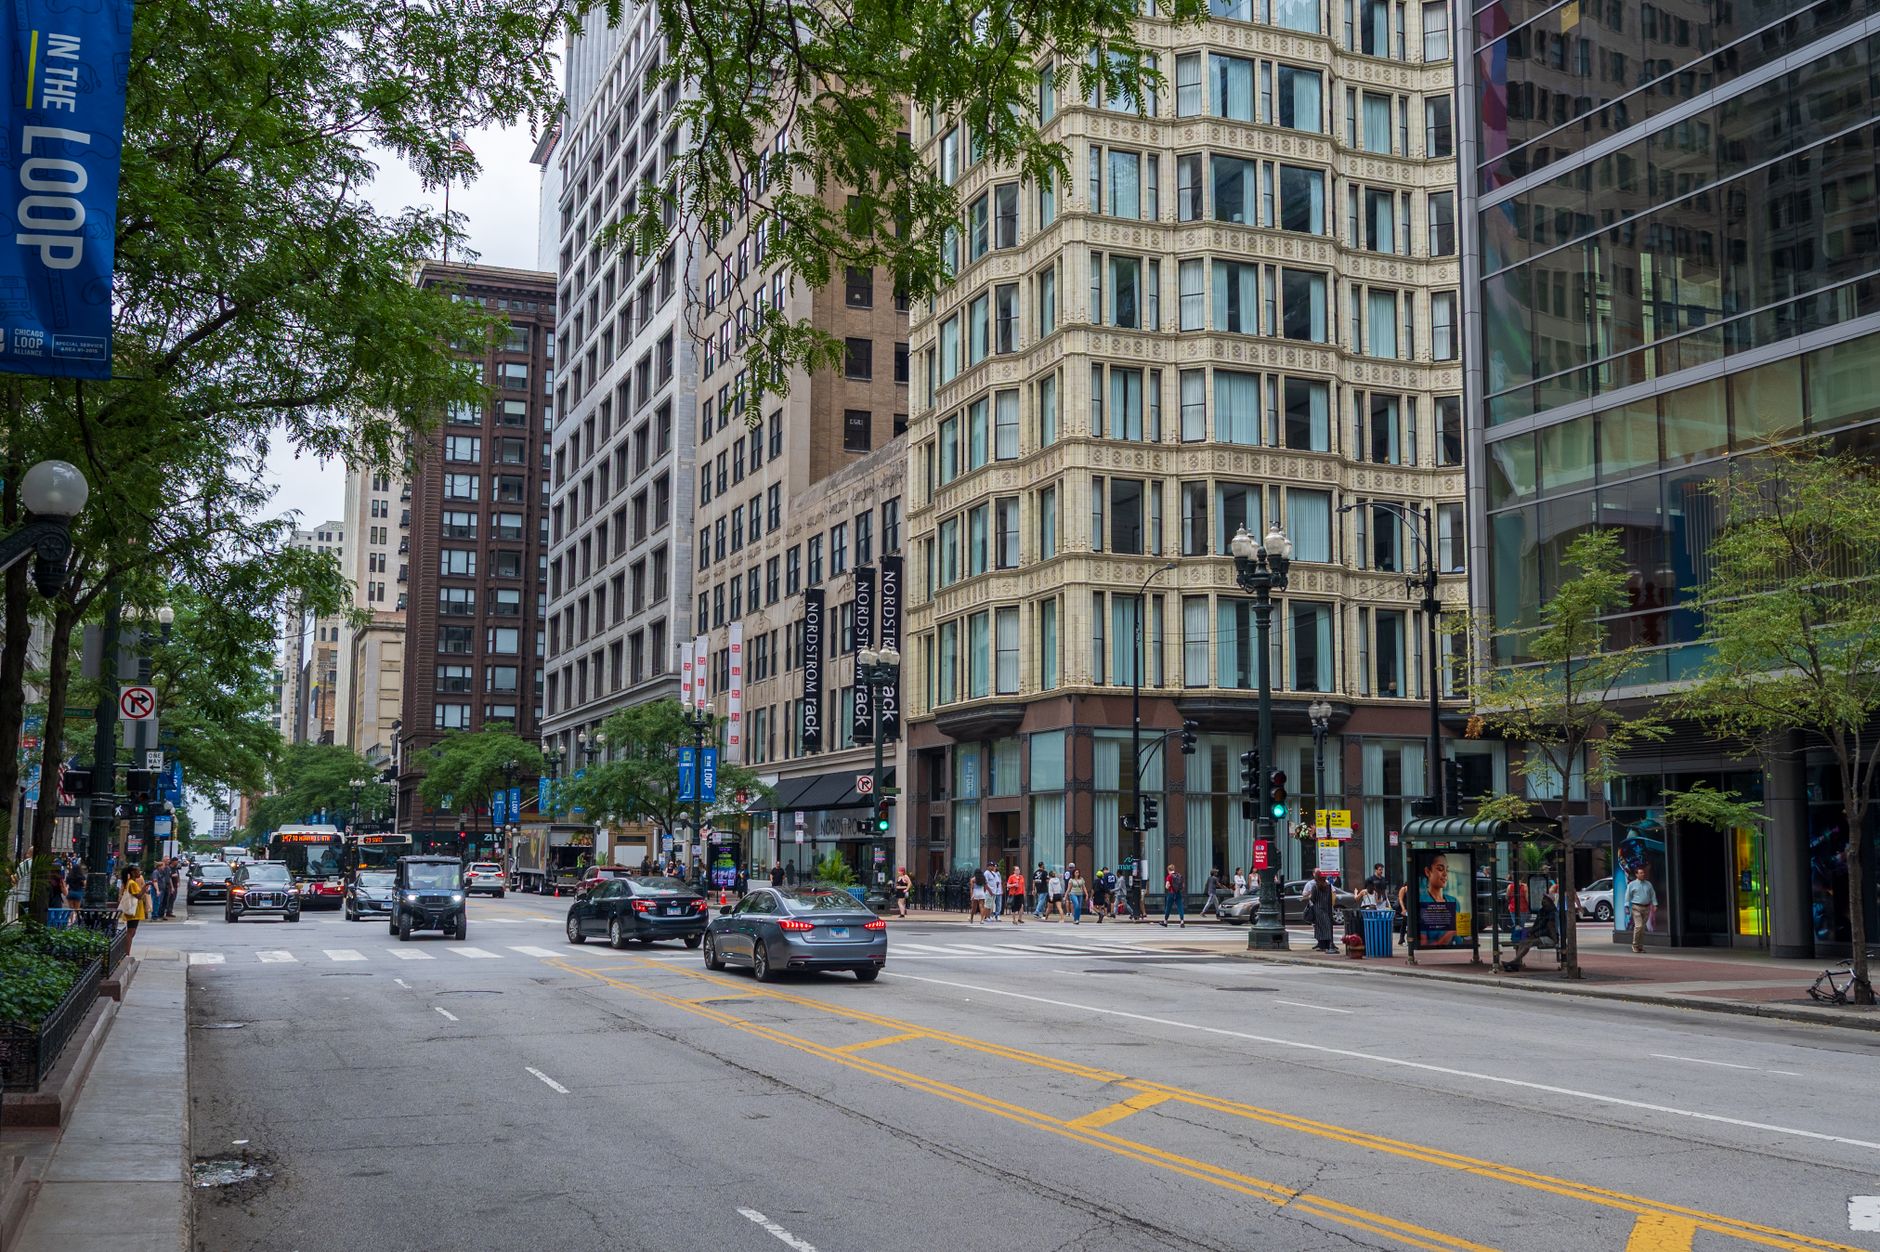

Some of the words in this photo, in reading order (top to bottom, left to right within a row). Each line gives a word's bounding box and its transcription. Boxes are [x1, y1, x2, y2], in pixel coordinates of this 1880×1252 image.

[47, 33, 81, 60] IN
[42, 67, 78, 113] THE
[16, 125, 91, 270] LOOP
[14, 328, 44, 338] CHICAGO
[14, 336, 43, 349] LOOP
[13, 348, 43, 357] ALLIANCE
[883, 571, 896, 649] NORDSTR
[805, 602, 819, 693] NORDSTROM
[856, 581, 870, 679] NORDSTRM
[804, 697, 820, 737] rack
[855, 684, 871, 727] rack
[882, 685, 898, 721] ack
[704, 769, 713, 789] LOOP
[820, 817, 862, 837] NORDSTRO
